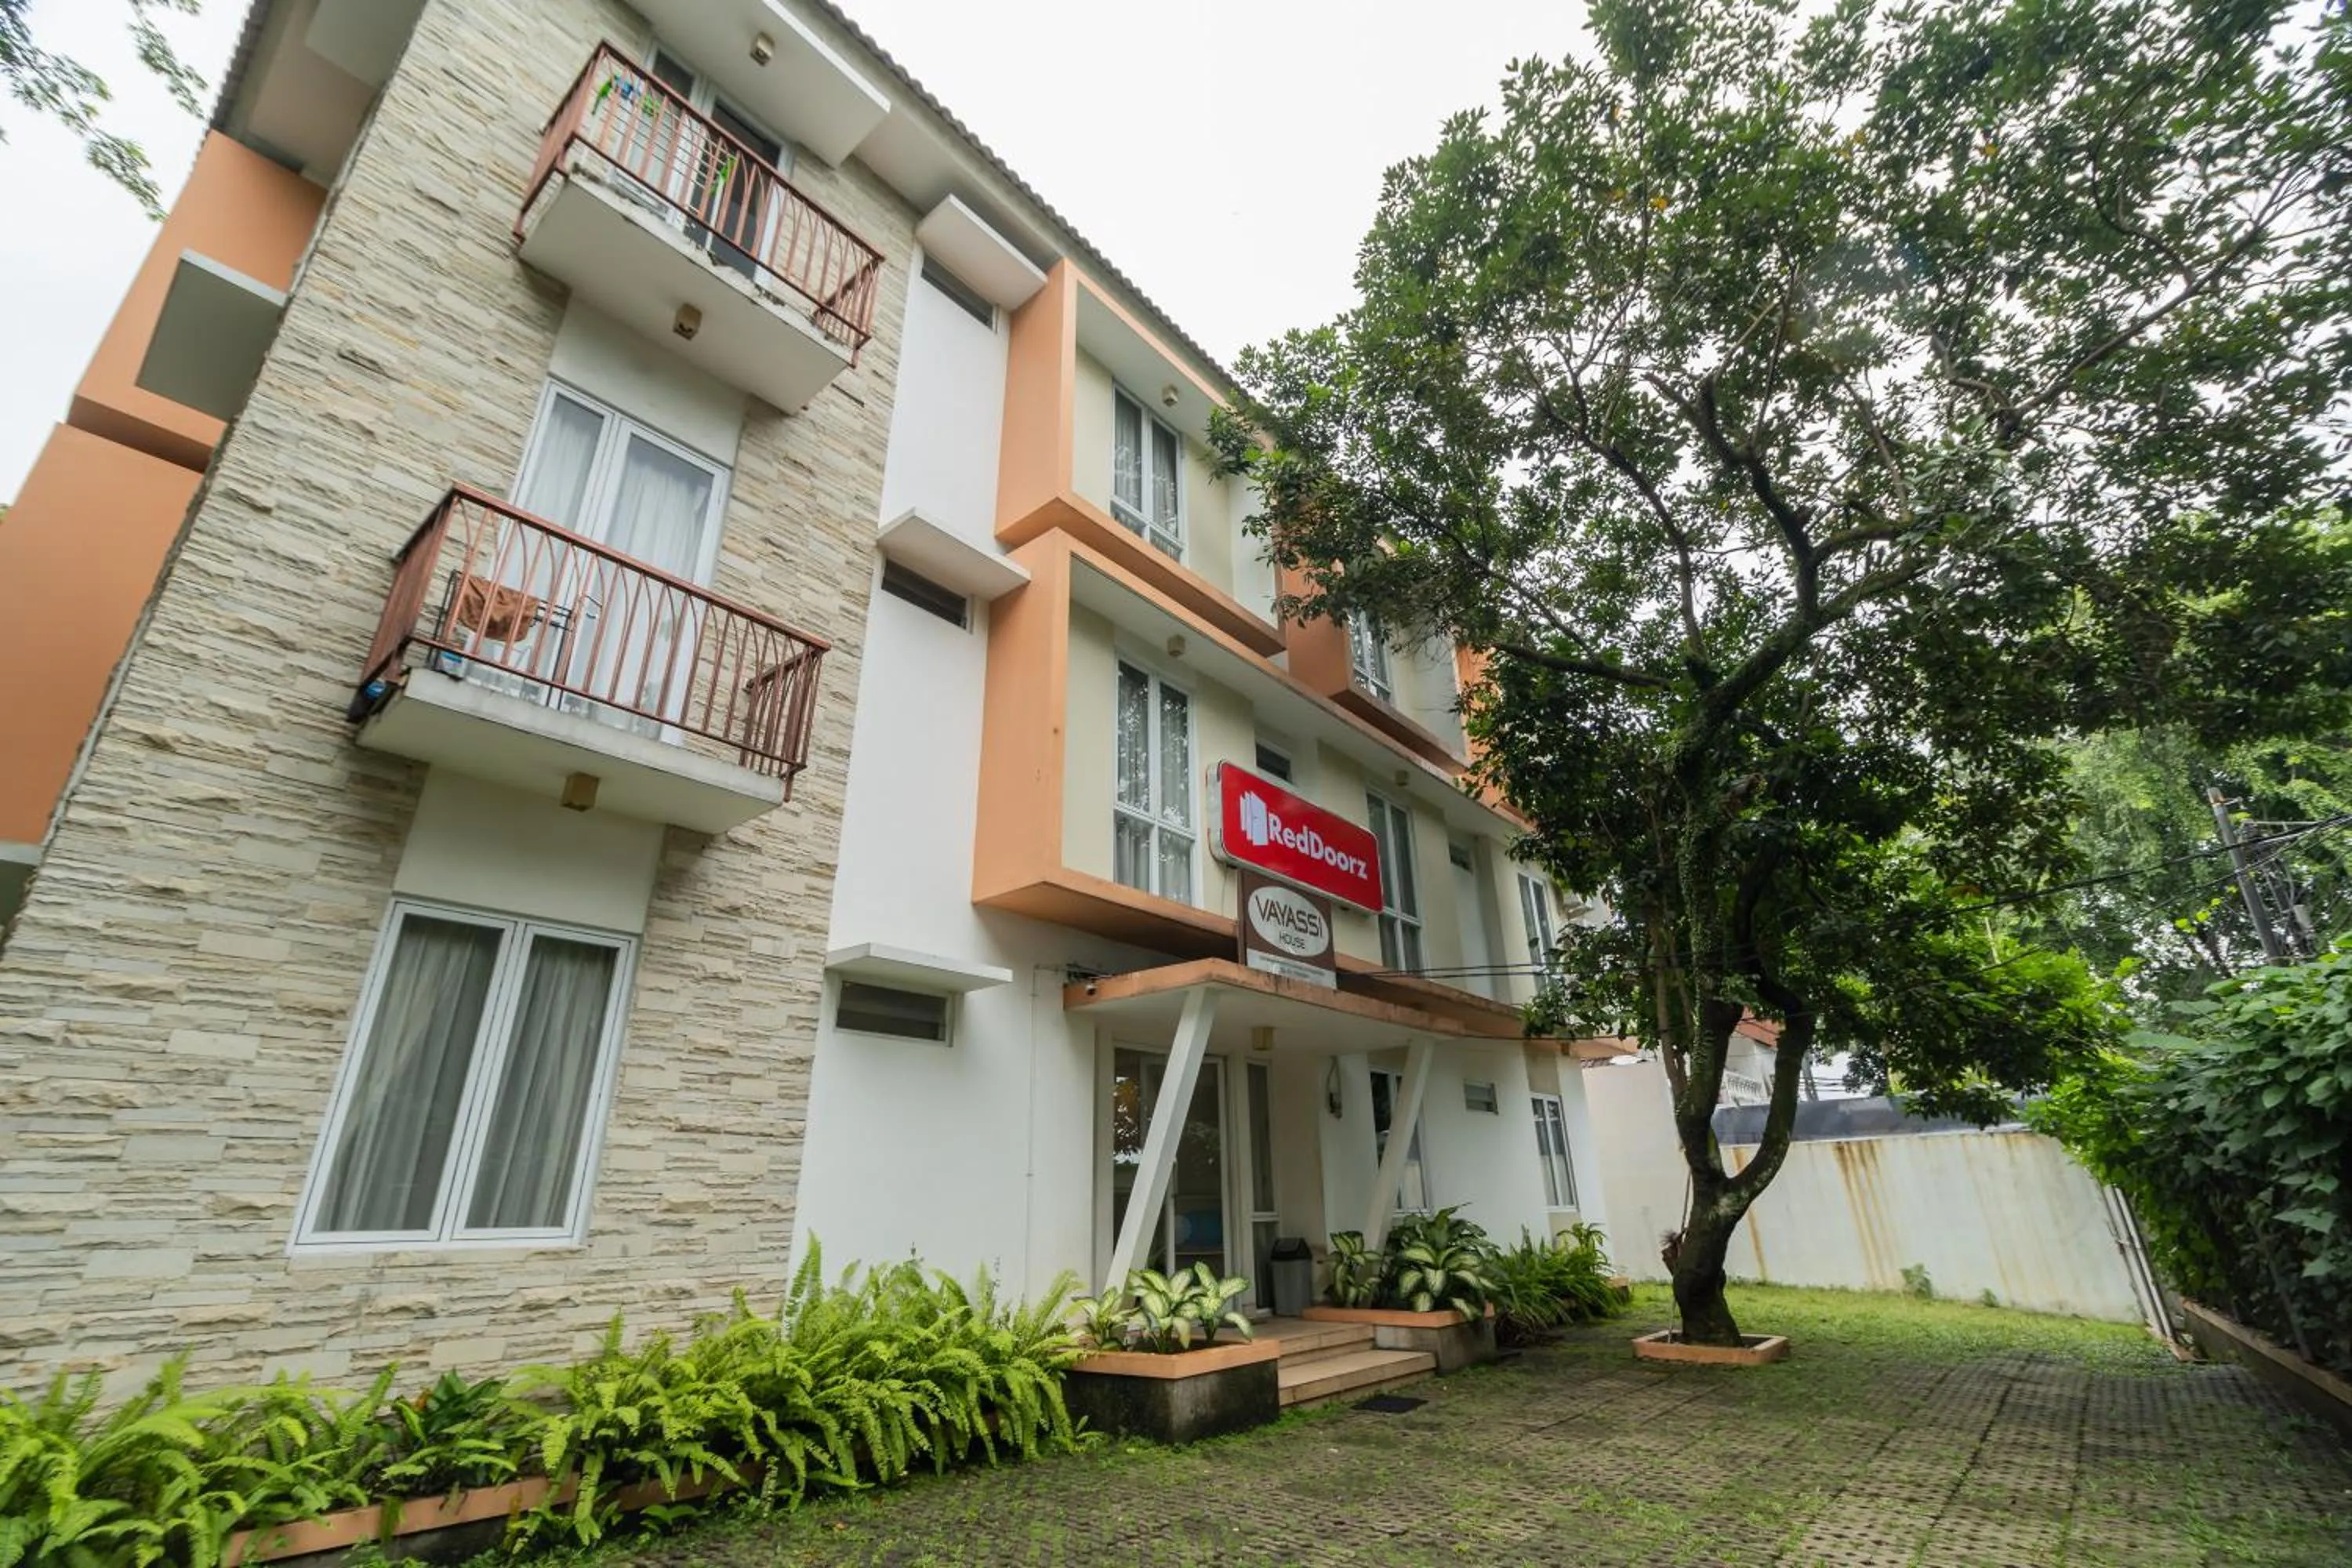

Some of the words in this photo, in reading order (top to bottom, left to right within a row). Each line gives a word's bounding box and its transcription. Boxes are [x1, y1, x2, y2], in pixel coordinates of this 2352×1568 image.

[1269, 813, 1367, 880] RedDoorz
[1255, 895, 1323, 938] VAYASSI
[1279, 931, 1305, 949] HOUSE
